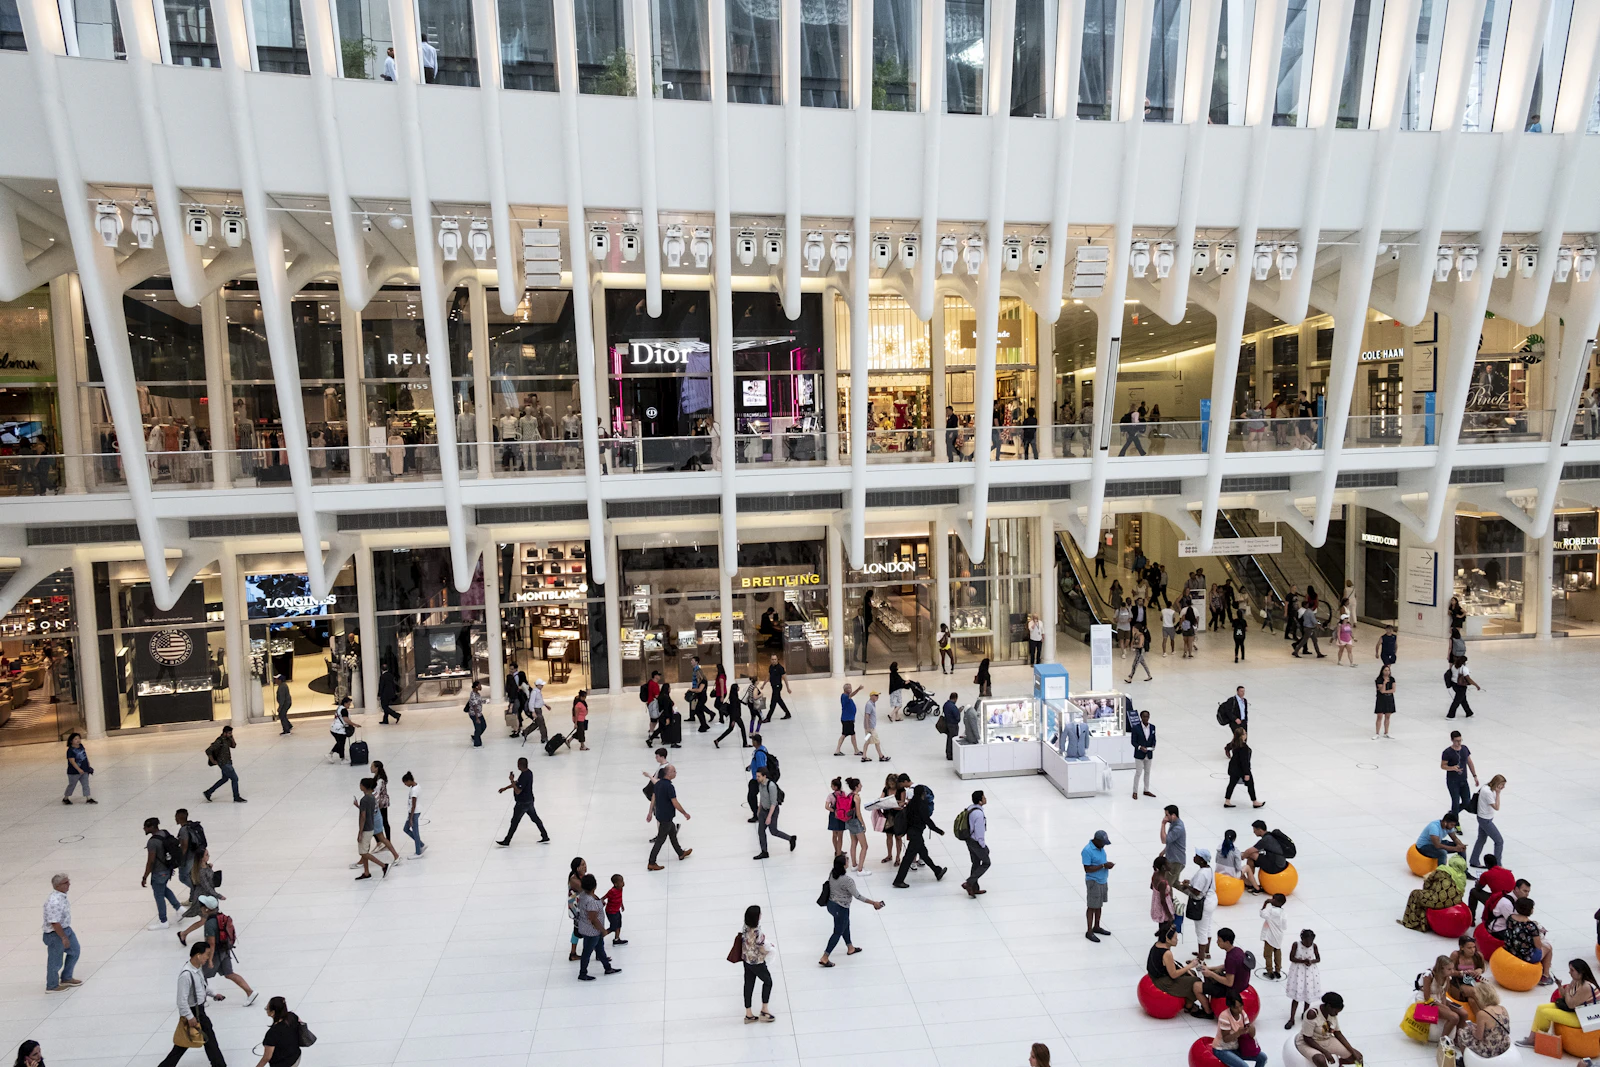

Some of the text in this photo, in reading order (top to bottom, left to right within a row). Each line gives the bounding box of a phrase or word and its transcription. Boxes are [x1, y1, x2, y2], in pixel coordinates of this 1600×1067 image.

[387, 353, 431, 365] REIS
[630, 343, 691, 365] Dior
[1362, 348, 1404, 361] COLE HAAN
[1466, 384, 1509, 411] Pinch
[1361, 533, 1398, 546] ROBERTO COIN
[863, 561, 916, 575] LONDON
[741, 574, 820, 588] BREITLING
[516, 590, 581, 602] MONTBLANC
[151, 637, 164, 663] EDITION
[1586, 1013, 1600, 1021] MoM
